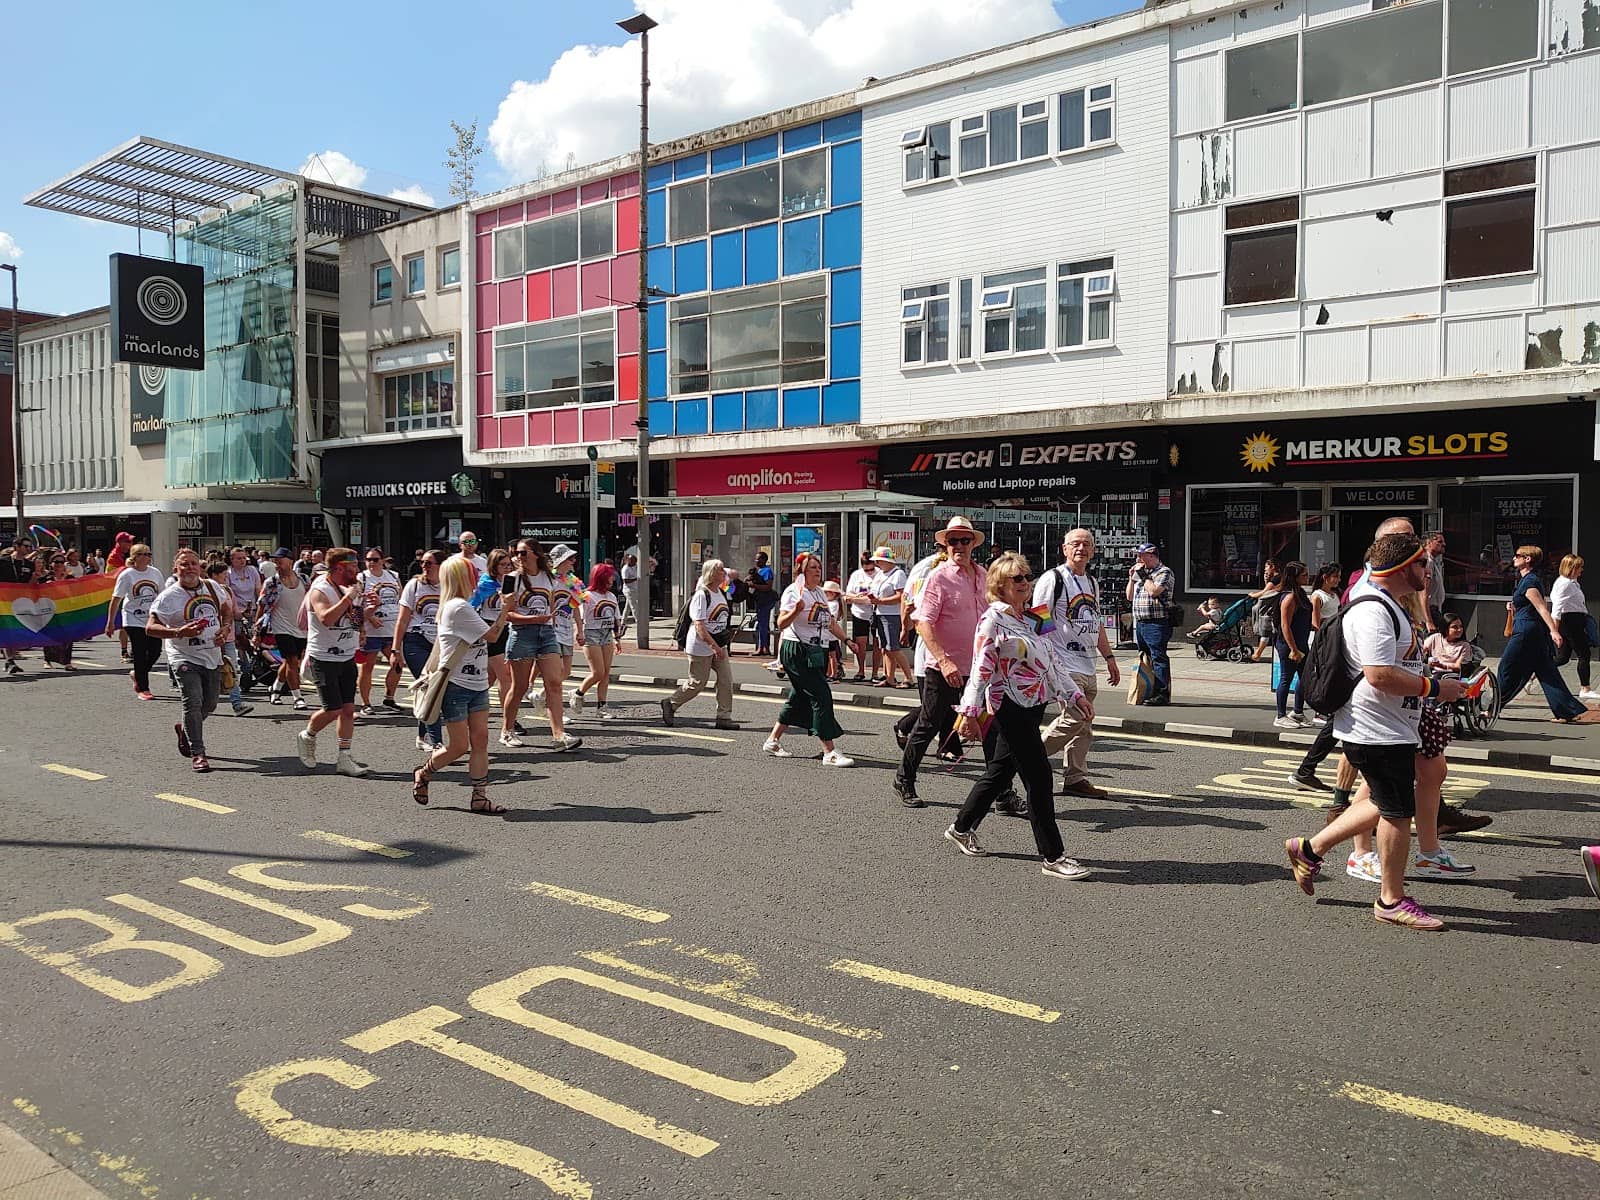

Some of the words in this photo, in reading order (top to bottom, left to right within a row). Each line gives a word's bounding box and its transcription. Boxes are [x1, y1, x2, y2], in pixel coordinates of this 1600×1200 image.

[124, 341, 200, 359] marlands
[133, 414, 166, 433] marlan
[1286, 437, 1402, 460] MERKUR
[1407, 431, 1509, 456] SLOTS
[933, 449, 995, 470] TECH
[1019, 440, 1137, 465] EXPERTS
[728, 468, 792, 490] amplifon
[943, 479, 975, 491] Mobile
[977, 478, 997, 489] and
[999, 477, 1036, 490] Laptop
[1038, 475, 1076, 488] repairs
[346, 483, 405, 498] STARBUCKS
[406, 481, 447, 496] COFFEE
[1346, 490, 1416, 502] WELCOME
[1224, 504, 1259, 512] MATCH
[1497, 499, 1543, 508] MATCH
[1227, 511, 1256, 519] PLAYS
[1501, 508, 1539, 517] PLAYS
[544, 528, 560, 536] Done
[889, 530, 899, 540] NOT
[0, 861, 432, 1003] BUS
[228, 937, 885, 1200] STOP
